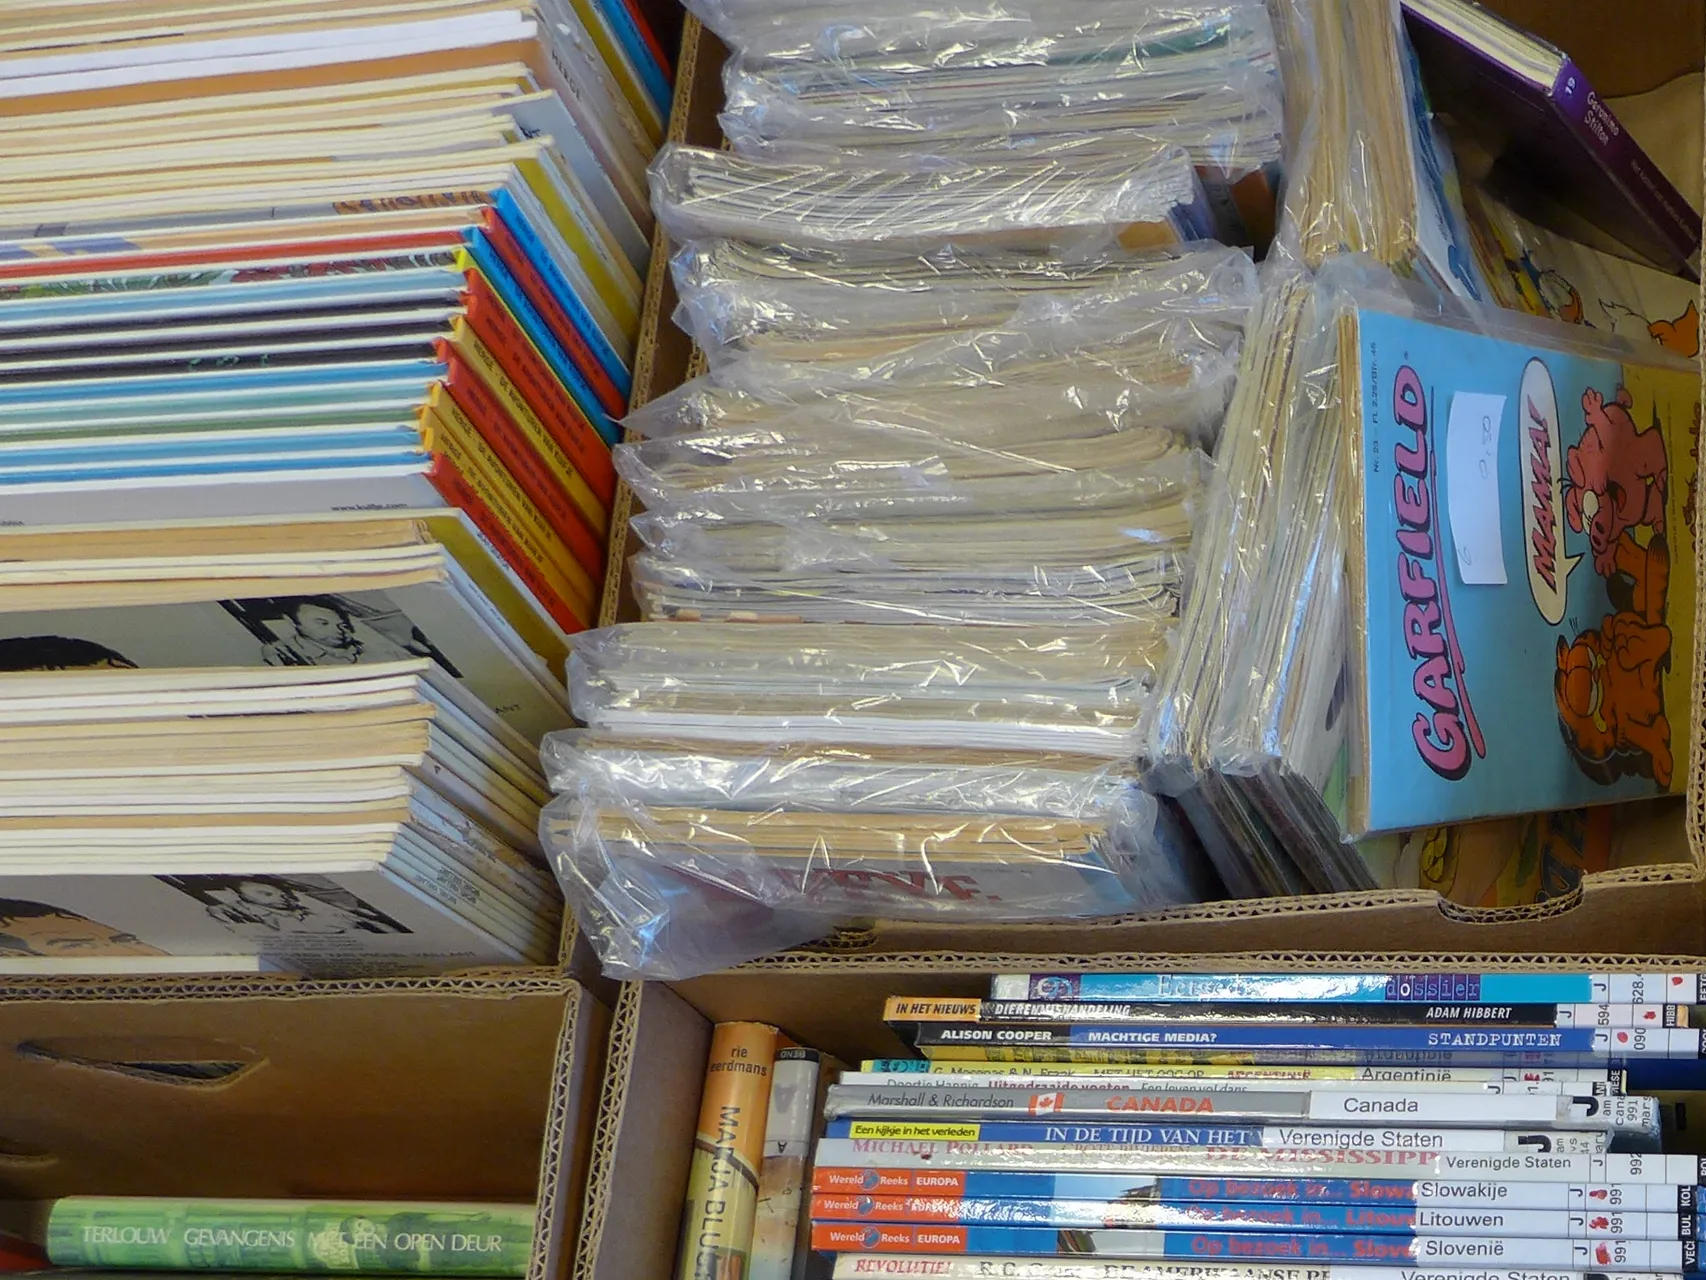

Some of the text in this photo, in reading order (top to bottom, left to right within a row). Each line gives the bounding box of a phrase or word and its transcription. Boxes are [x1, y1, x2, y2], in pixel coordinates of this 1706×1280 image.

[1587, 91, 1619, 136] Geronimo
[1584, 110, 1609, 146] Stilton
[1527, 393, 1560, 595] MAMA!
[1392, 364, 1472, 782] GARFIELD
[933, 1003, 977, 1016] NIEUWS
[1426, 1006, 1512, 1021] ADAM HIBBERT
[941, 1029, 1218, 1044] ALISON COOPER MACHTIGE MEDIA?
[1428, 1032, 1562, 1048] STANDPUNTEN
[944, 1094, 1214, 1114] Richardson CANADA
[1343, 1097, 1419, 1114] Canada
[931, 1127, 976, 1137] verleden
[1158, 1129, 1248, 1145] VAN HET
[1279, 1129, 1444, 1149] Verenigde Staten
[1446, 1155, 1572, 1171] Verenigde Staten
[829, 1174, 959, 1187] Wereld EUROPA
[1421, 1182, 1508, 1200] Slowakije
[1419, 1212, 1504, 1228] Litouwen
[82, 1225, 295, 1249] TERLOUW GEVANGENIS
[394, 1232, 503, 1253] OPEN DEUR
[829, 1231, 961, 1244] Wereld EUROPA
[1425, 1239, 1504, 1257] Slovenië
